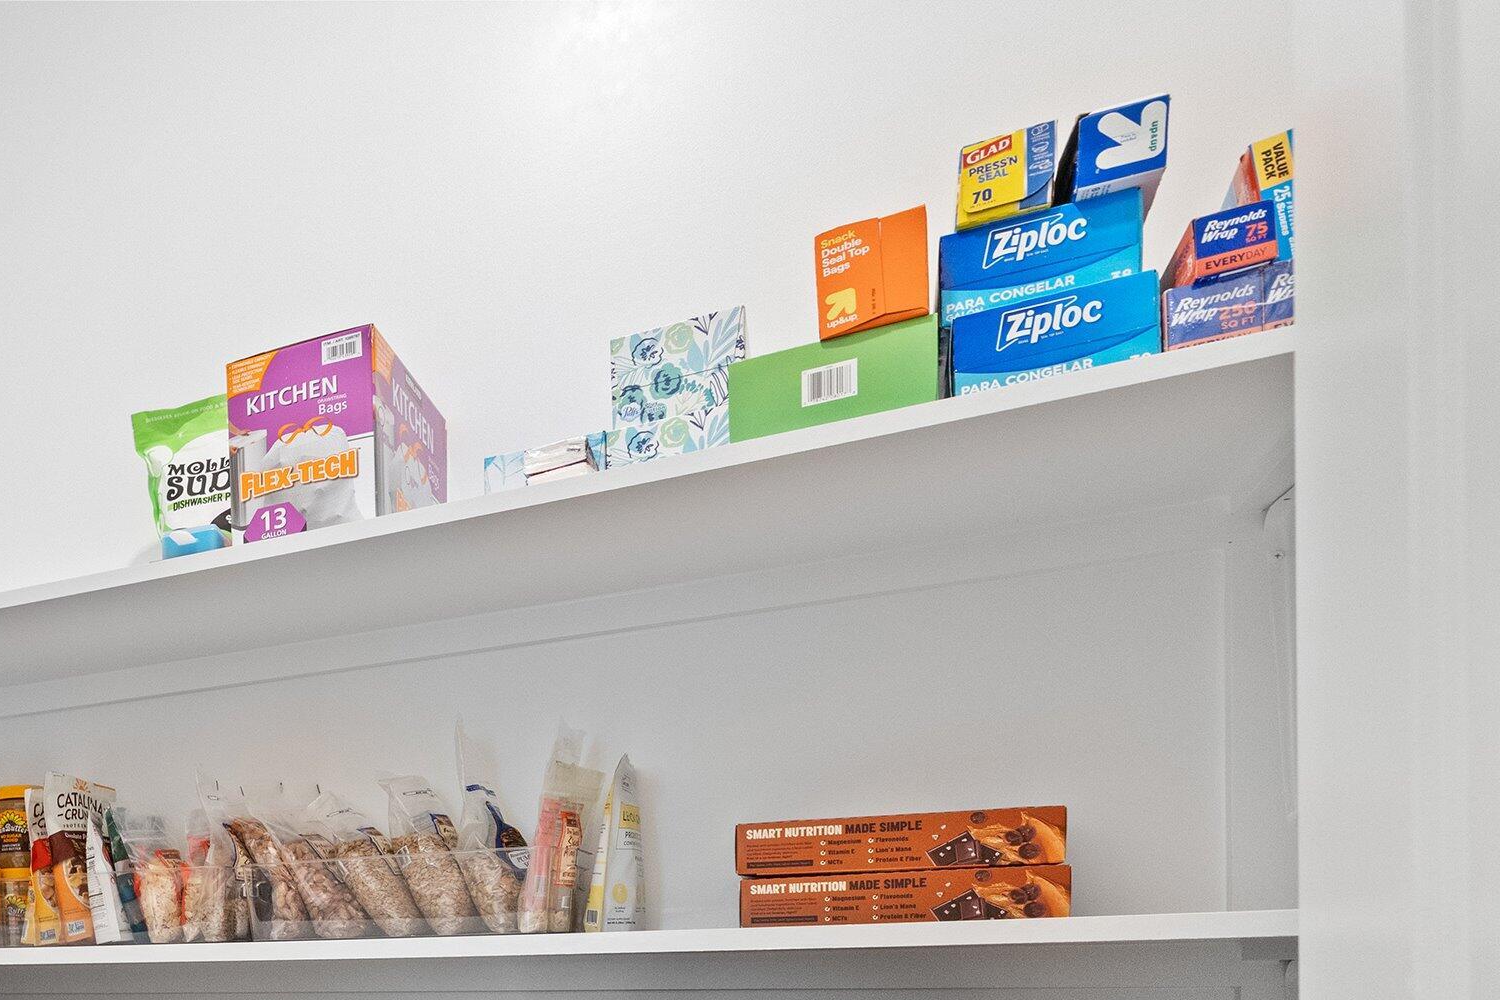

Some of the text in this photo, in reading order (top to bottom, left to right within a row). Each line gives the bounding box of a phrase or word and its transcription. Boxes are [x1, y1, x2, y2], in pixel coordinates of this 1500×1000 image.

[966, 136, 1012, 164] GLAD
[1273, 141, 1290, 179] VALUE
[1262, 149, 1277, 180] PACK
[978, 169, 1008, 184] SEAL
[972, 188, 992, 205] 70
[1273, 185, 1285, 203] 25
[1206, 209, 1268, 232] Reynolds
[821, 230, 856, 249] Snack
[991, 217, 1087, 262] Ziploc
[1202, 222, 1269, 245] Wrap 75
[821, 238, 862, 259] Double
[822, 245, 870, 268] Seal Top
[1205, 248, 1266, 270] EVERYDAY
[823, 261, 851, 277] Bags
[946, 274, 1075, 314] PARA CONGELAR
[1176, 284, 1254, 312] Reynolds
[826, 313, 858, 329] up&up
[1005, 300, 1103, 345] Ziploc
[1171, 306, 1218, 328] Wrap
[961, 358, 1094, 397] PARA CONGELAR
[246, 375, 338, 416] KITCHEN
[318, 399, 348, 416] Bags
[393, 378, 434, 453] KITCHEN
[240, 449, 359, 501] FLEX-TECH
[173, 494, 221, 512] DISHWASHER
[260, 506, 287, 531] 13
[261, 529, 287, 539] GALLON
[746, 820, 923, 840] SMART NUTRITION MADE SIMPLE
[827, 838, 861, 846] Magnesium
[750, 877, 927, 895] SMART NUTRITION MADE SIMPLE
